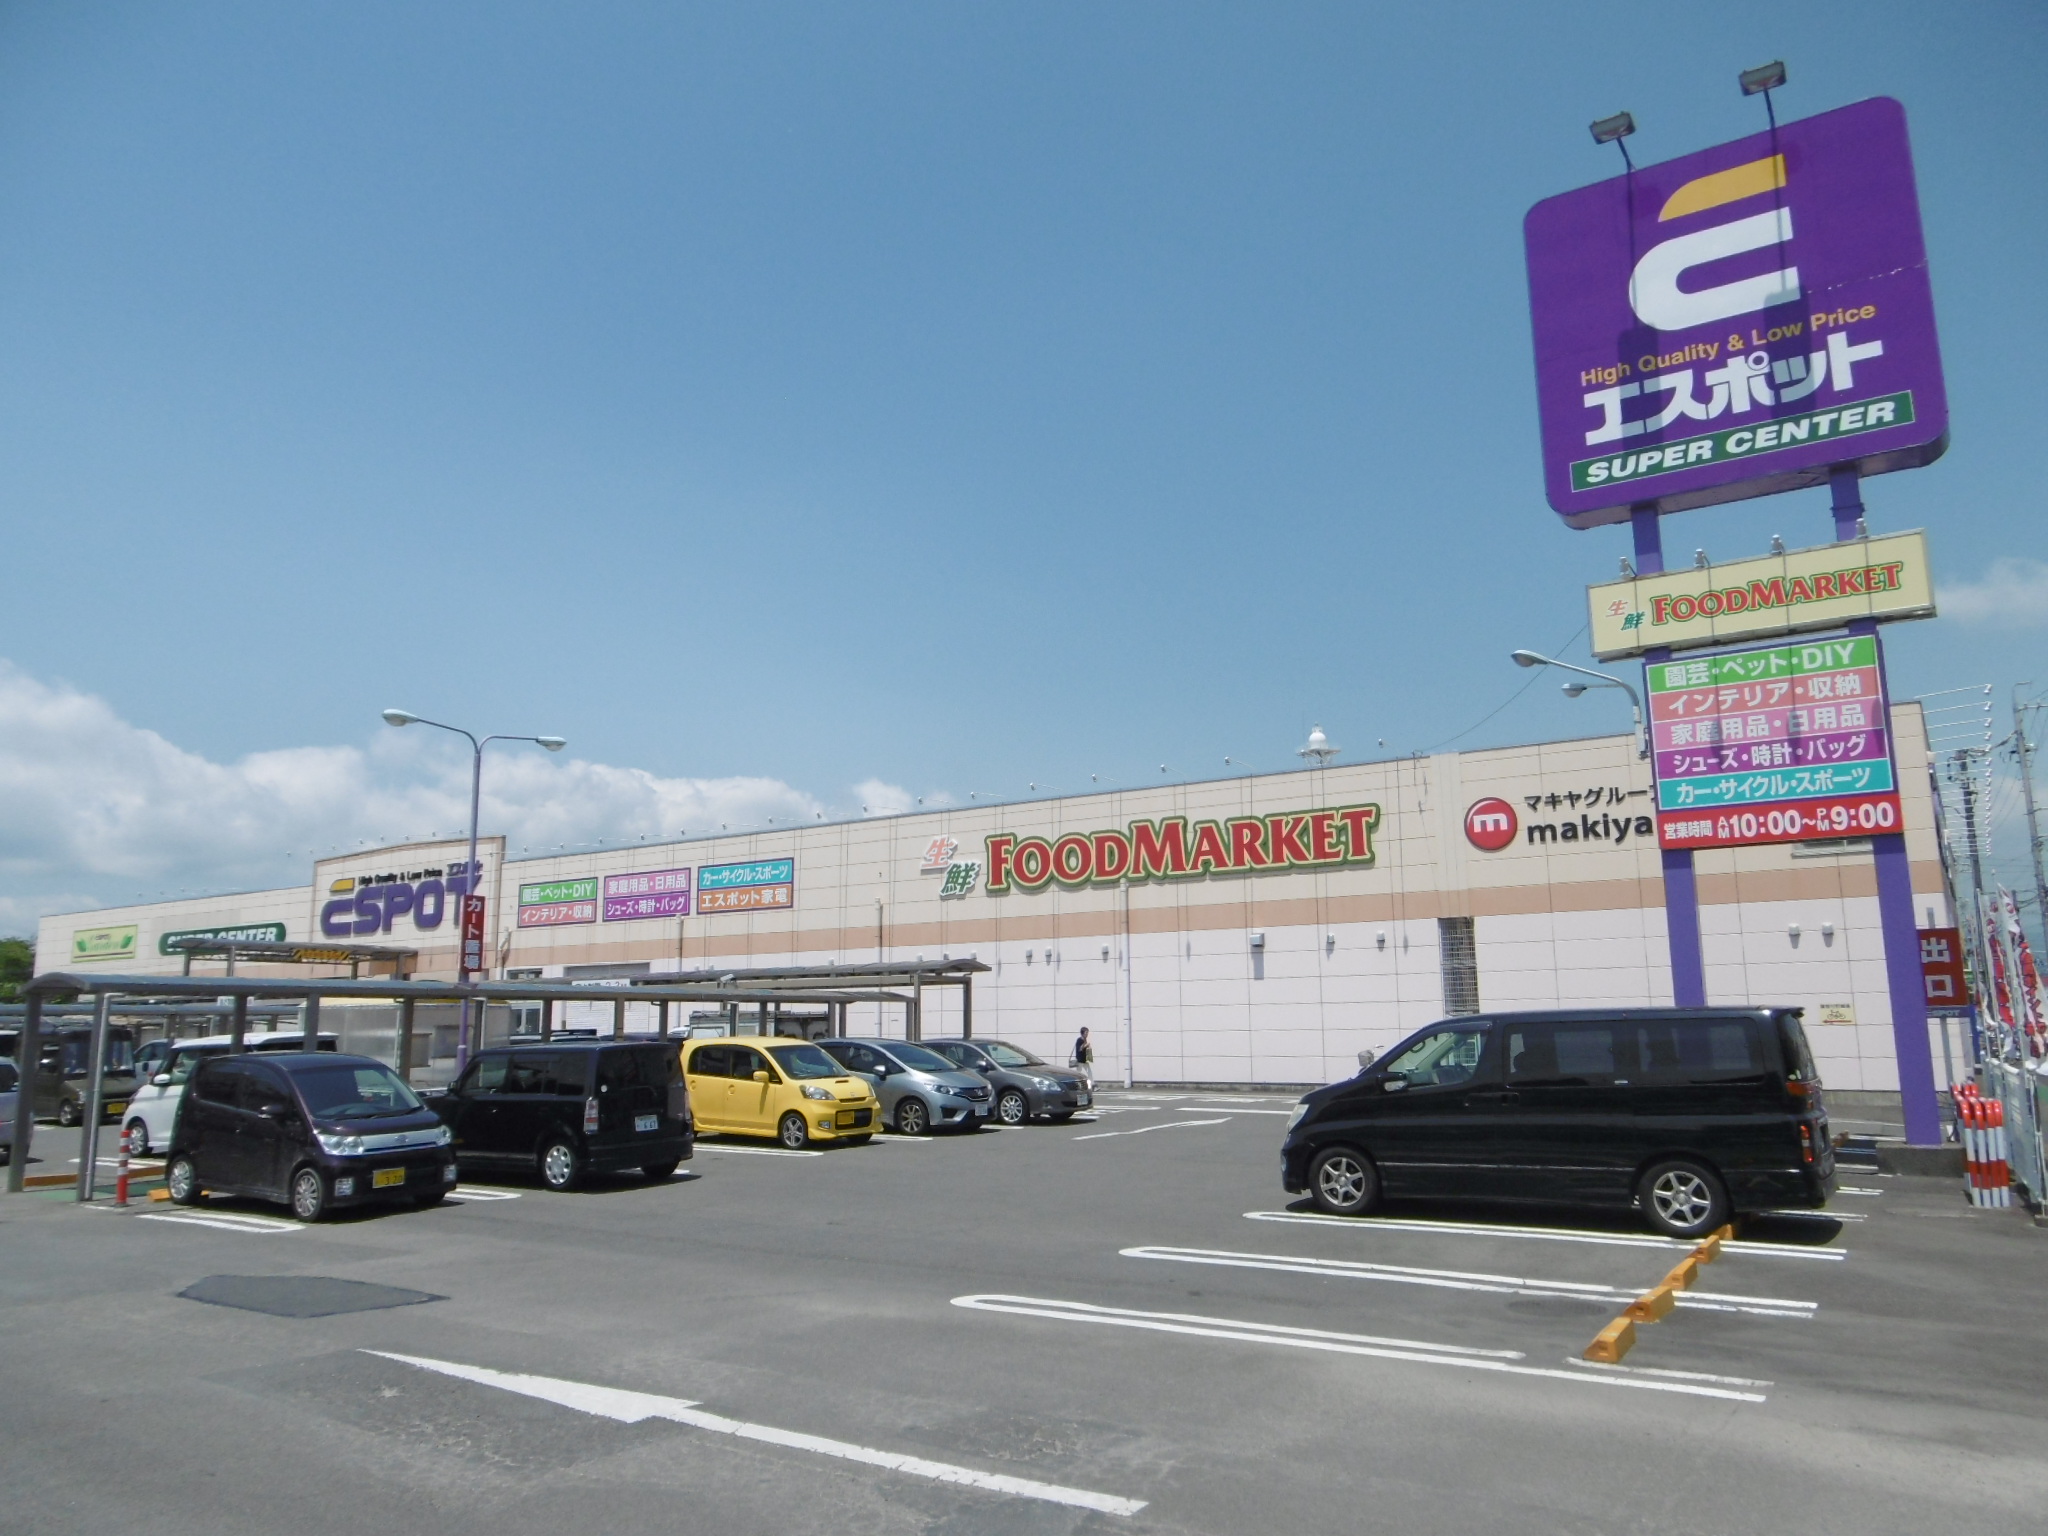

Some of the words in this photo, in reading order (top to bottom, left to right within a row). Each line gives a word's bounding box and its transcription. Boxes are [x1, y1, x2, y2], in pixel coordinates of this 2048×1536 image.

[1581, 362, 1631, 388] High
[1638, 341, 1720, 373] Quality
[1728, 334, 1744, 351] &
[1752, 320, 1803, 345] Low
[1811, 304, 1876, 331] Price
[1583, 331, 1884, 446] エスポット
[1586, 439, 1713, 483] SUPER
[1725, 401, 1896, 454] CENTER
[1664, 642, 1855, 688] 園芸・ペット・DIY
[1668, 673, 1862, 715] インテリア・収納
[1670, 703, 1866, 746] 家庭用品・日用品
[1673, 734, 1867, 775] シューズ・時計・バッグ
[1676, 766, 1872, 804] カー・サイクル・スポーツ
[1527, 813, 1654, 844] makiya
[1663, 820, 1713, 840] 営業時間
[608, 874, 687, 894] 家庭用品・日用品
[702, 865, 789, 886] カー・サイクル・スポーツ
[522, 905, 592, 922] インテリア・収納
[607, 896, 686, 916] シューズ・時計・バッグ
[702, 888, 788, 908] エスポット家電
[1920, 937, 1953, 997] 出口
